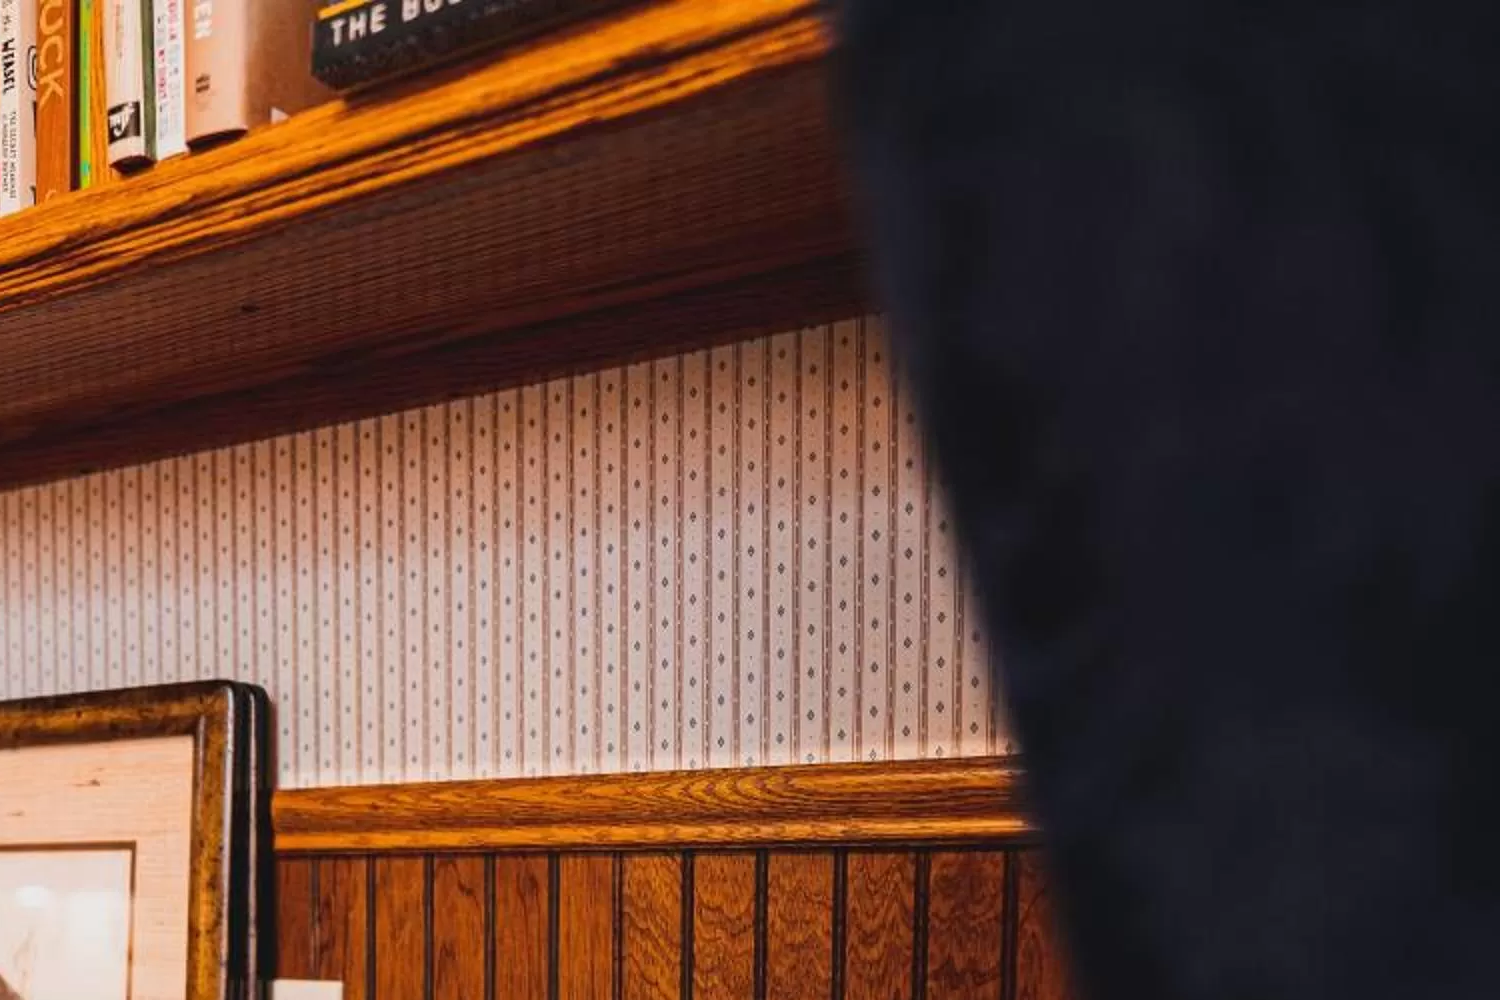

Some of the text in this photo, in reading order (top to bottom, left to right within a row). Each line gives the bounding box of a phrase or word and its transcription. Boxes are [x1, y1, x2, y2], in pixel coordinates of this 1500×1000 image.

[329, 3, 388, 47] THE
[1, 38, 17, 95] WEASEL
[39, 0, 65, 108] UCK
